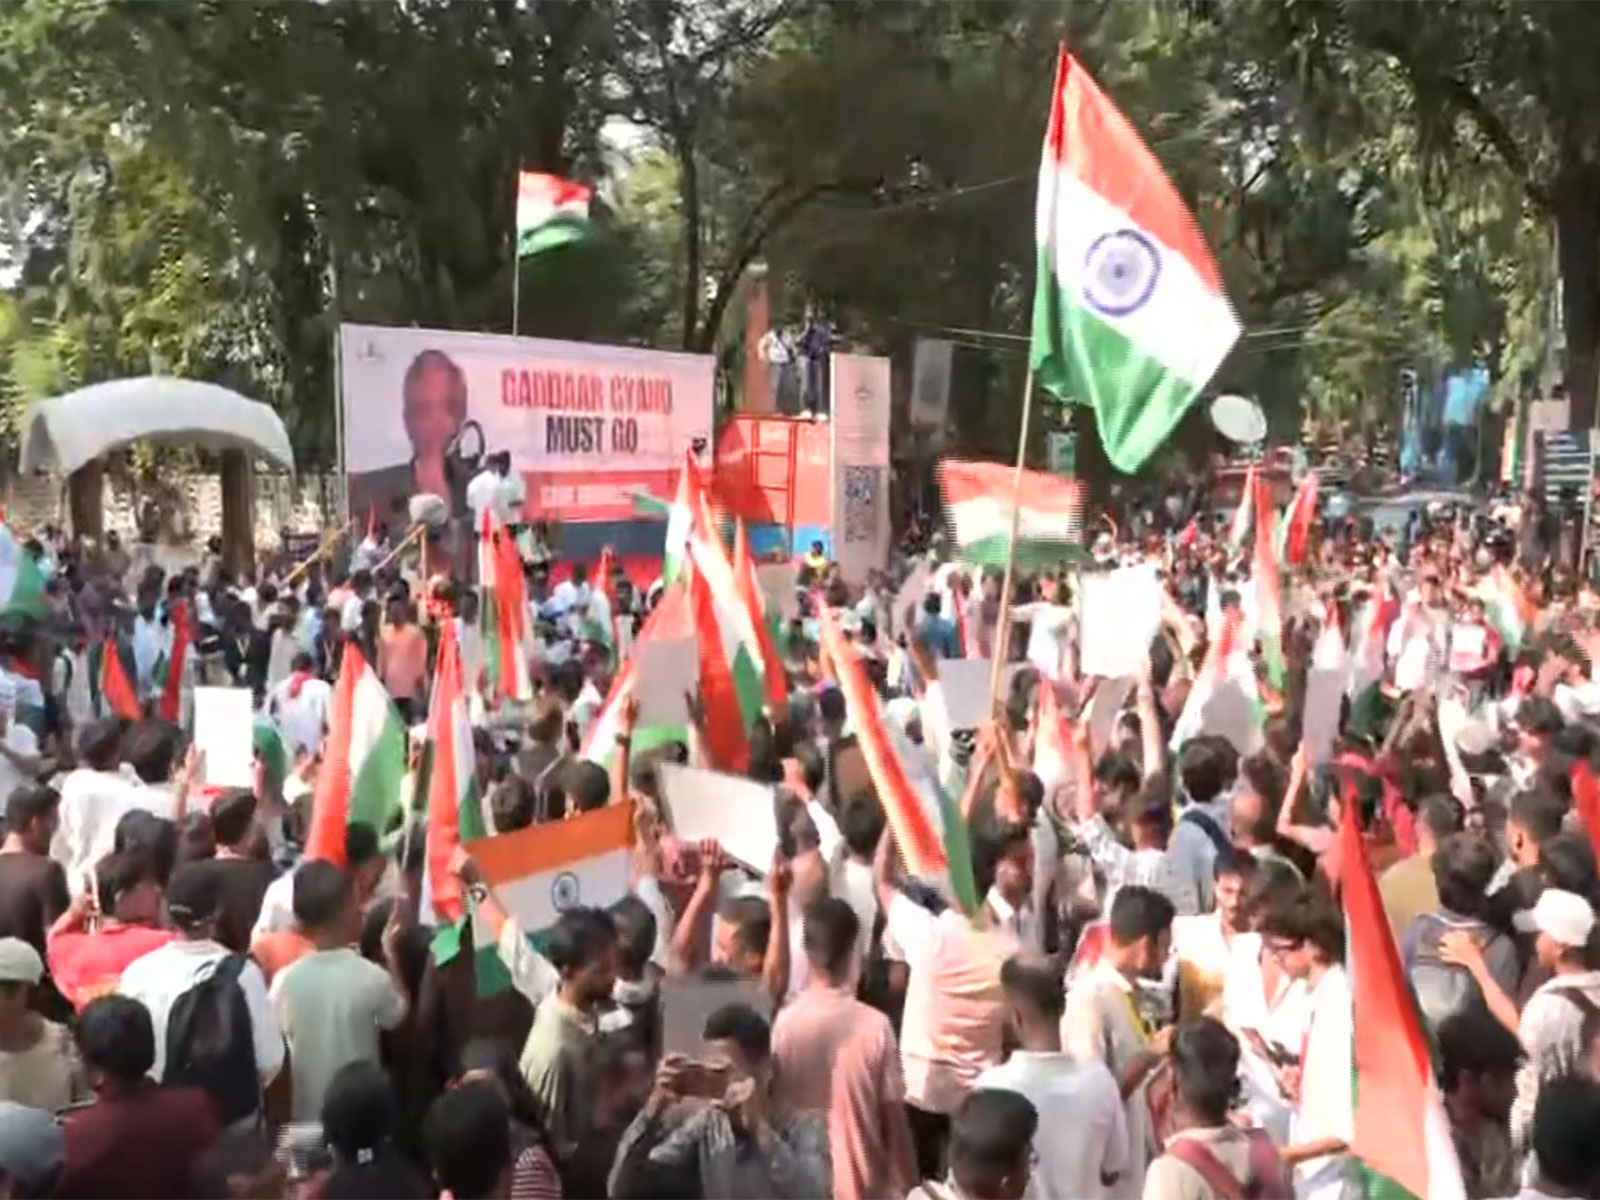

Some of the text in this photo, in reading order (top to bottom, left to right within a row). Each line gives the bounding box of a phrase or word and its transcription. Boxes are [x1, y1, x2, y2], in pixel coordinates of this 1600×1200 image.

[502, 369, 603, 411] GADDAAR
[546, 415, 638, 453] MUST GO
